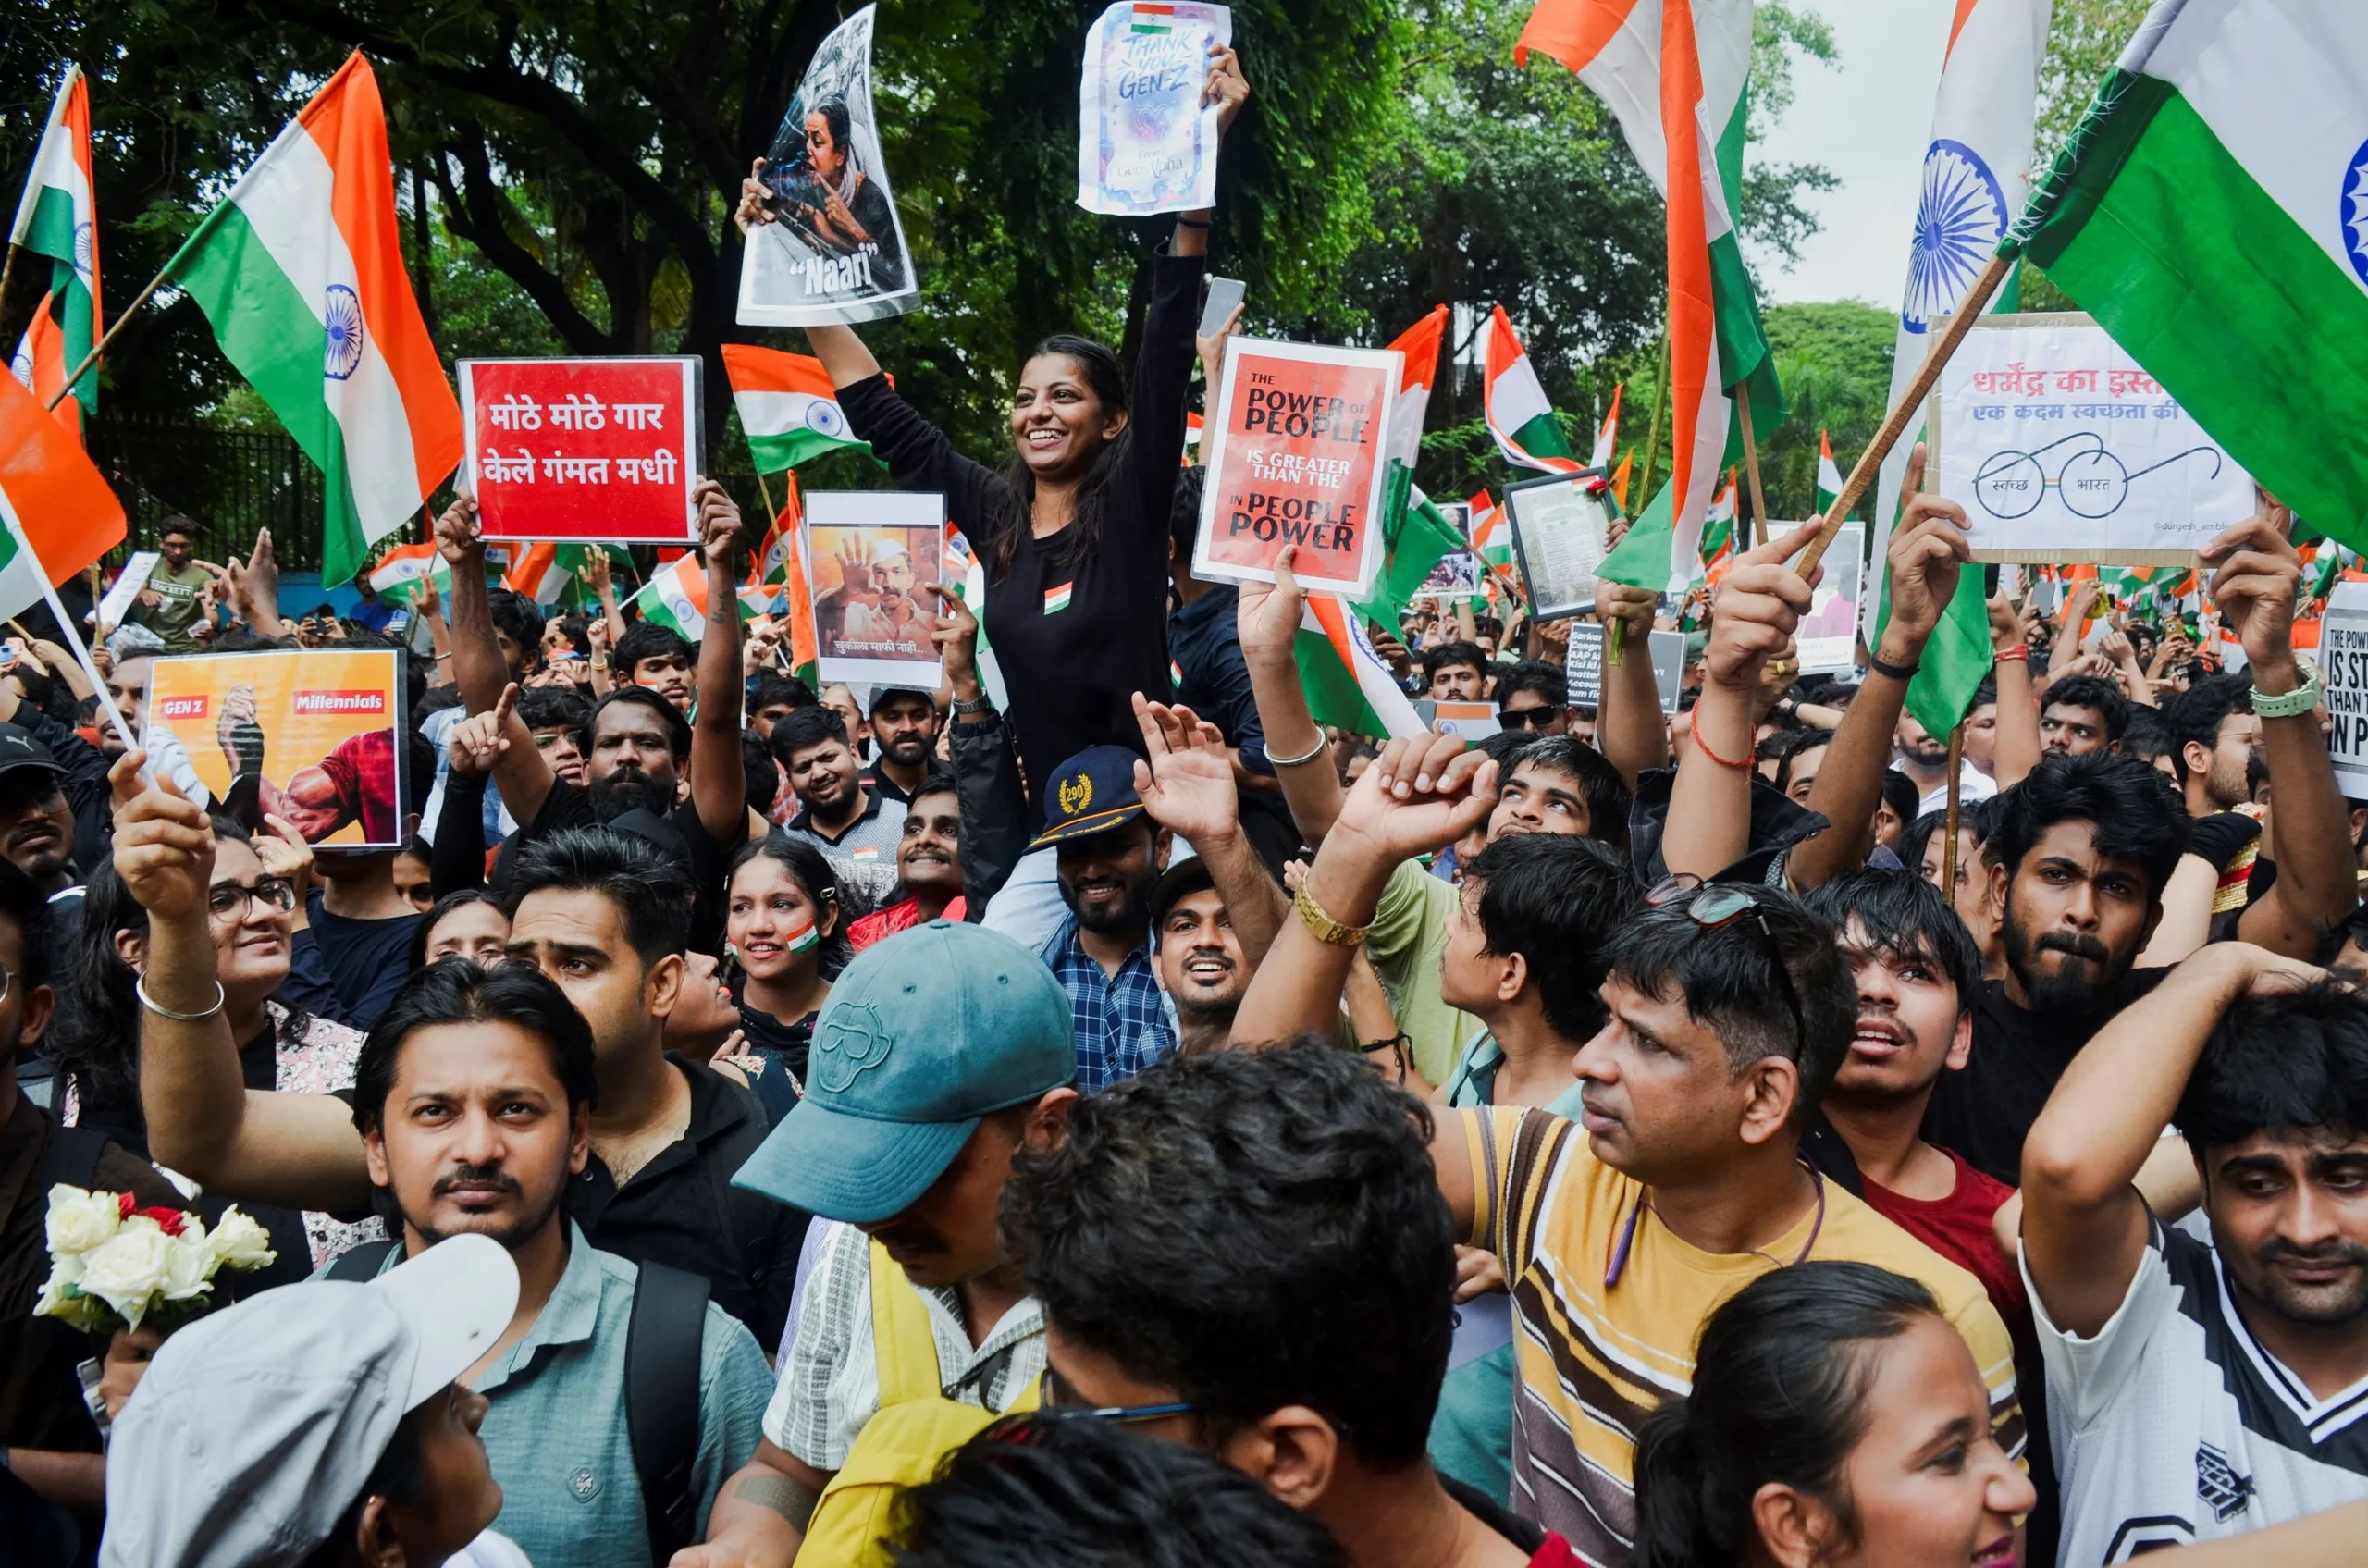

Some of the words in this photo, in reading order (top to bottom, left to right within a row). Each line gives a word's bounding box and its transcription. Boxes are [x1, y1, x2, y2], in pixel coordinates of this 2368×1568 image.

[1121, 30, 1194, 58] THANK
[1138, 52, 1176, 76] YOU
[1119, 63, 1190, 100] GEN-Z
[1251, 372, 1275, 385] THE
[1972, 362, 2048, 398] धर्मेंद्र
[2056, 369, 2097, 394] का
[2107, 369, 2164, 398] इस्त
[489, 394, 542, 430] मोठे
[549, 394, 607, 430] मोठे
[612, 403, 664, 430] गार
[1248, 388, 1345, 416] POWER
[1350, 403, 1367, 414] OF
[1972, 405, 2006, 421] एक
[2014, 404, 2065, 421] कदम
[2071, 404, 2146, 420] स्वच्छता
[2152, 400, 2179, 420] की
[1245, 407, 1370, 444] PEOPLE
[483, 448, 536, 484] केले
[542, 450, 610, 485] गंमत
[616, 448, 677, 485] मधी
[1247, 449, 1264, 463] IS
[1270, 452, 1351, 475] GREATER
[1252, 464, 1301, 484] THAN
[1307, 472, 1341, 488] THE
[1992, 479, 2029, 492] स्वच्छ
[2077, 479, 2110, 491] भारत
[1229, 495, 1243, 506] IN
[1248, 492, 1356, 526] PEOPLE
[1229, 512, 1354, 552] POWER
[833, 638, 869, 654] चुकीला
[870, 640, 894, 652] माफी
[2330, 629, 2344, 648] THE
[2346, 631, 2368, 649] POW
[2328, 650, 2344, 688] IS
[2348, 651, 2368, 689] ST
[1568, 679, 1601, 688] Accoun
[164, 701, 191, 715] GEN
[192, 700, 203, 713] Z
[296, 694, 383, 710] Millennials
[2327, 689, 2361, 713] THAN
[2327, 713, 2349, 754] IN
[1066, 784, 1084, 802] 290
